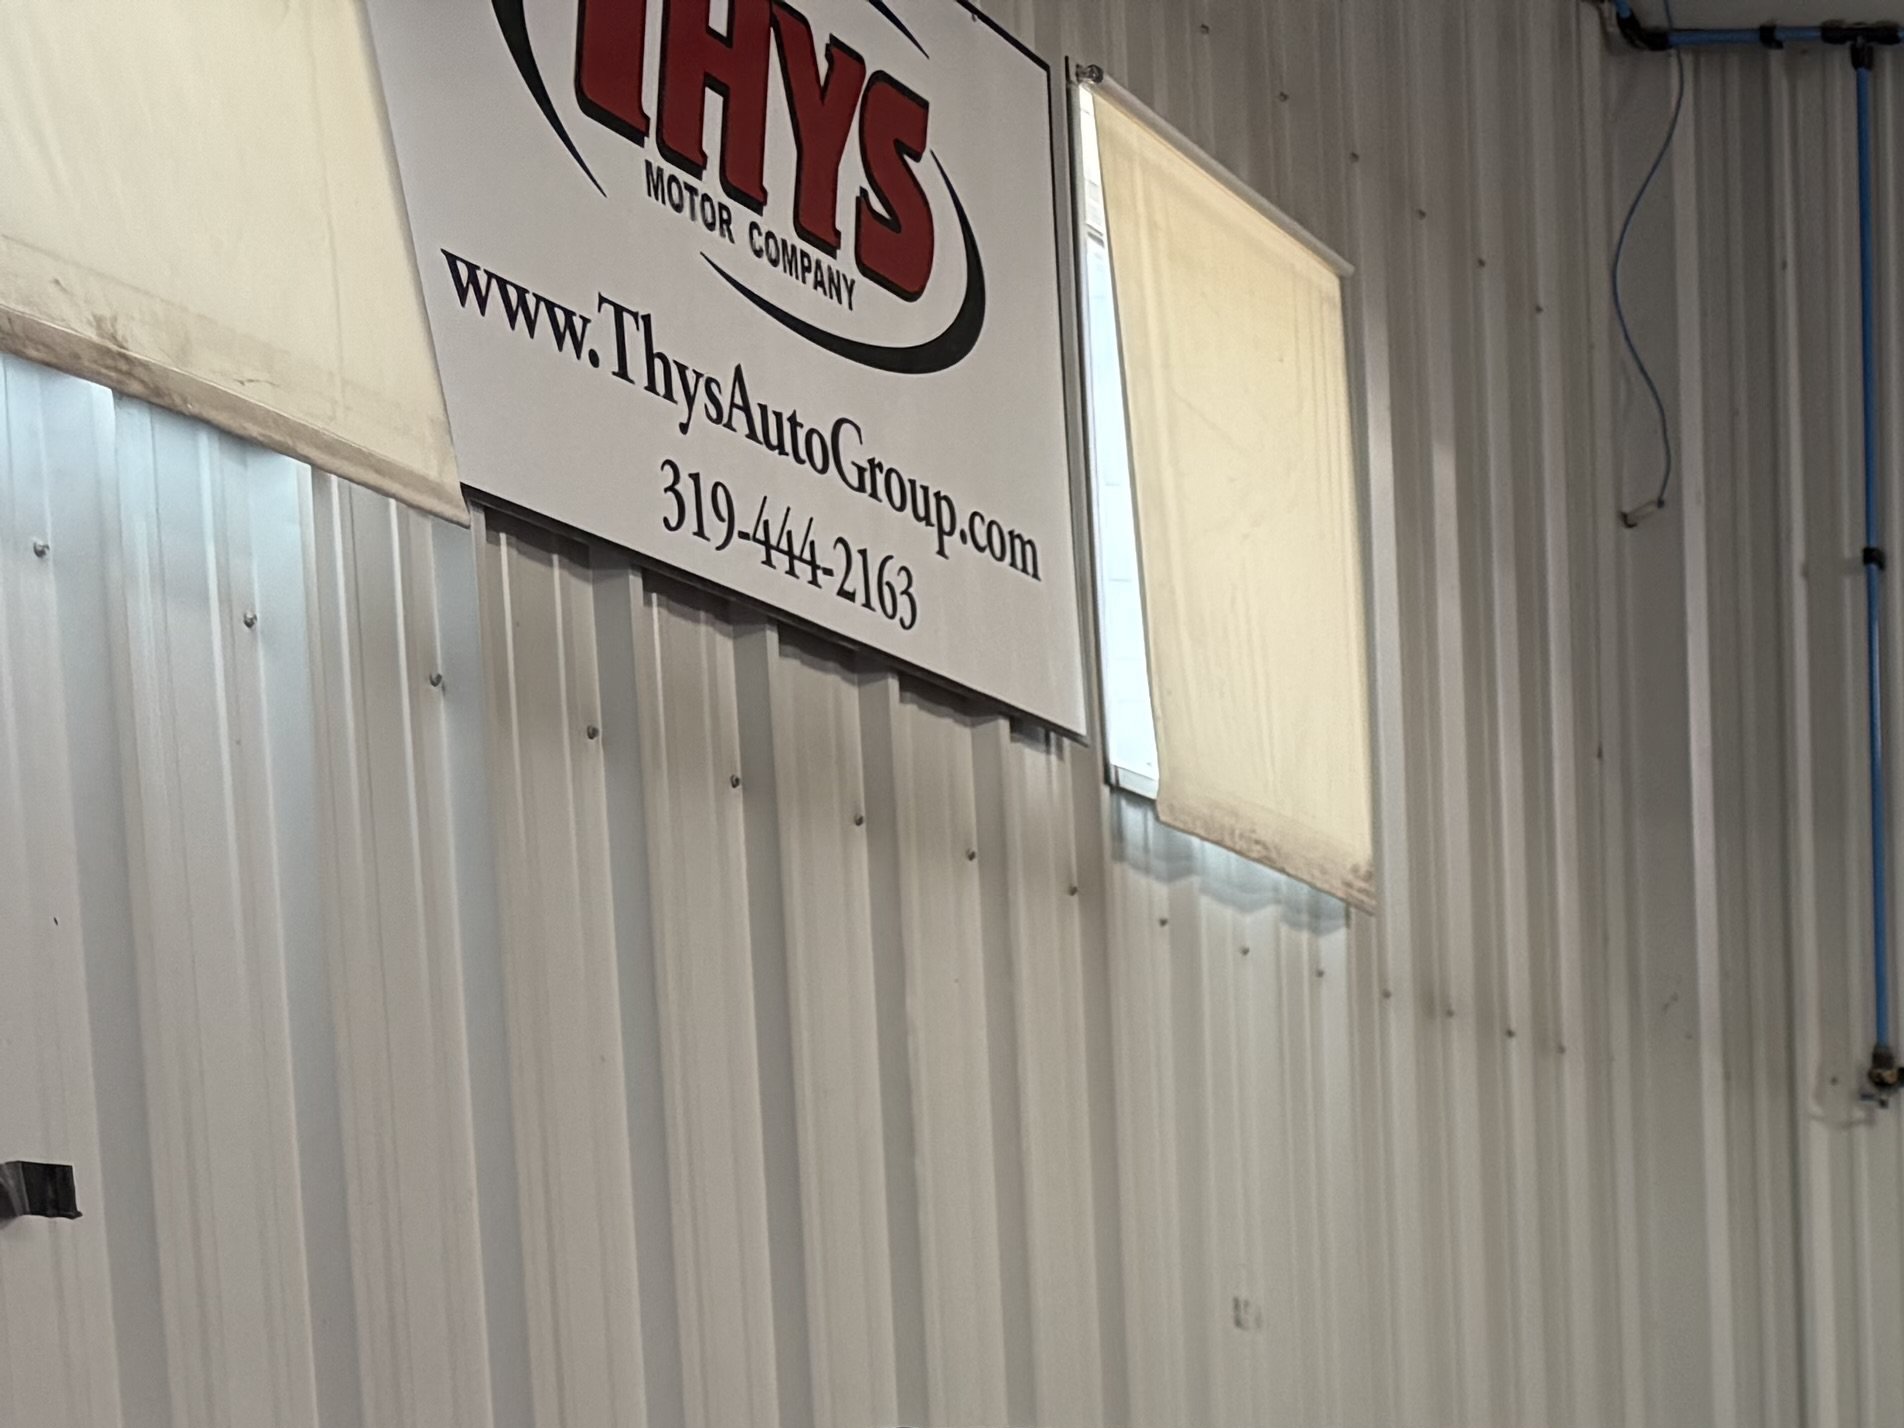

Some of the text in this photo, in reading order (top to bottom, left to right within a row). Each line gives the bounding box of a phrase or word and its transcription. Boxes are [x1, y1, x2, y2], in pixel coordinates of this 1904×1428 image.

[644, 159, 856, 311] MOTOR COMPANY
[440, 248, 1042, 582] www.ThysAutoGroup.com
[660, 458, 919, 631] 319-444-2163
